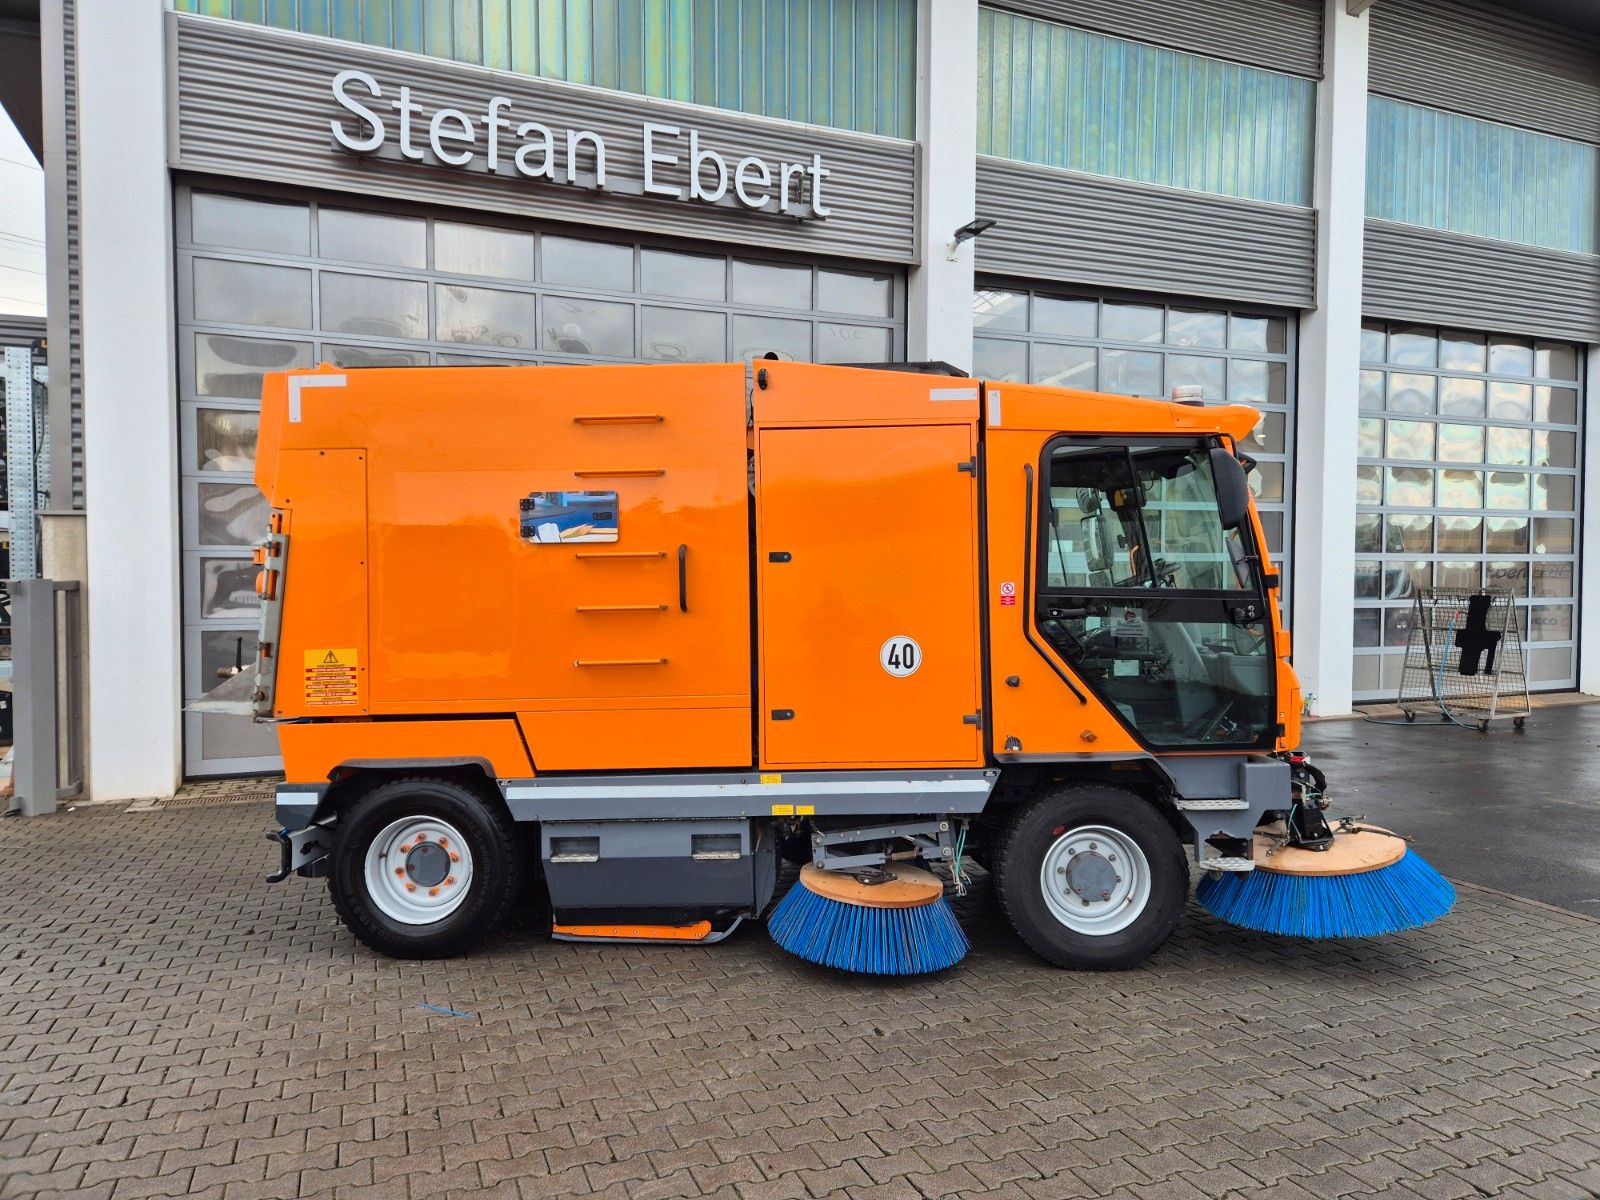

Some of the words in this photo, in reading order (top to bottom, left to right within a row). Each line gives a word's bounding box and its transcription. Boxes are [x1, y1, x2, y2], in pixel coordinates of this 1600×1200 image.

[330, 70, 606, 188] Stefan
[643, 122, 831, 219] Ebert
[888, 643, 914, 669] 40
